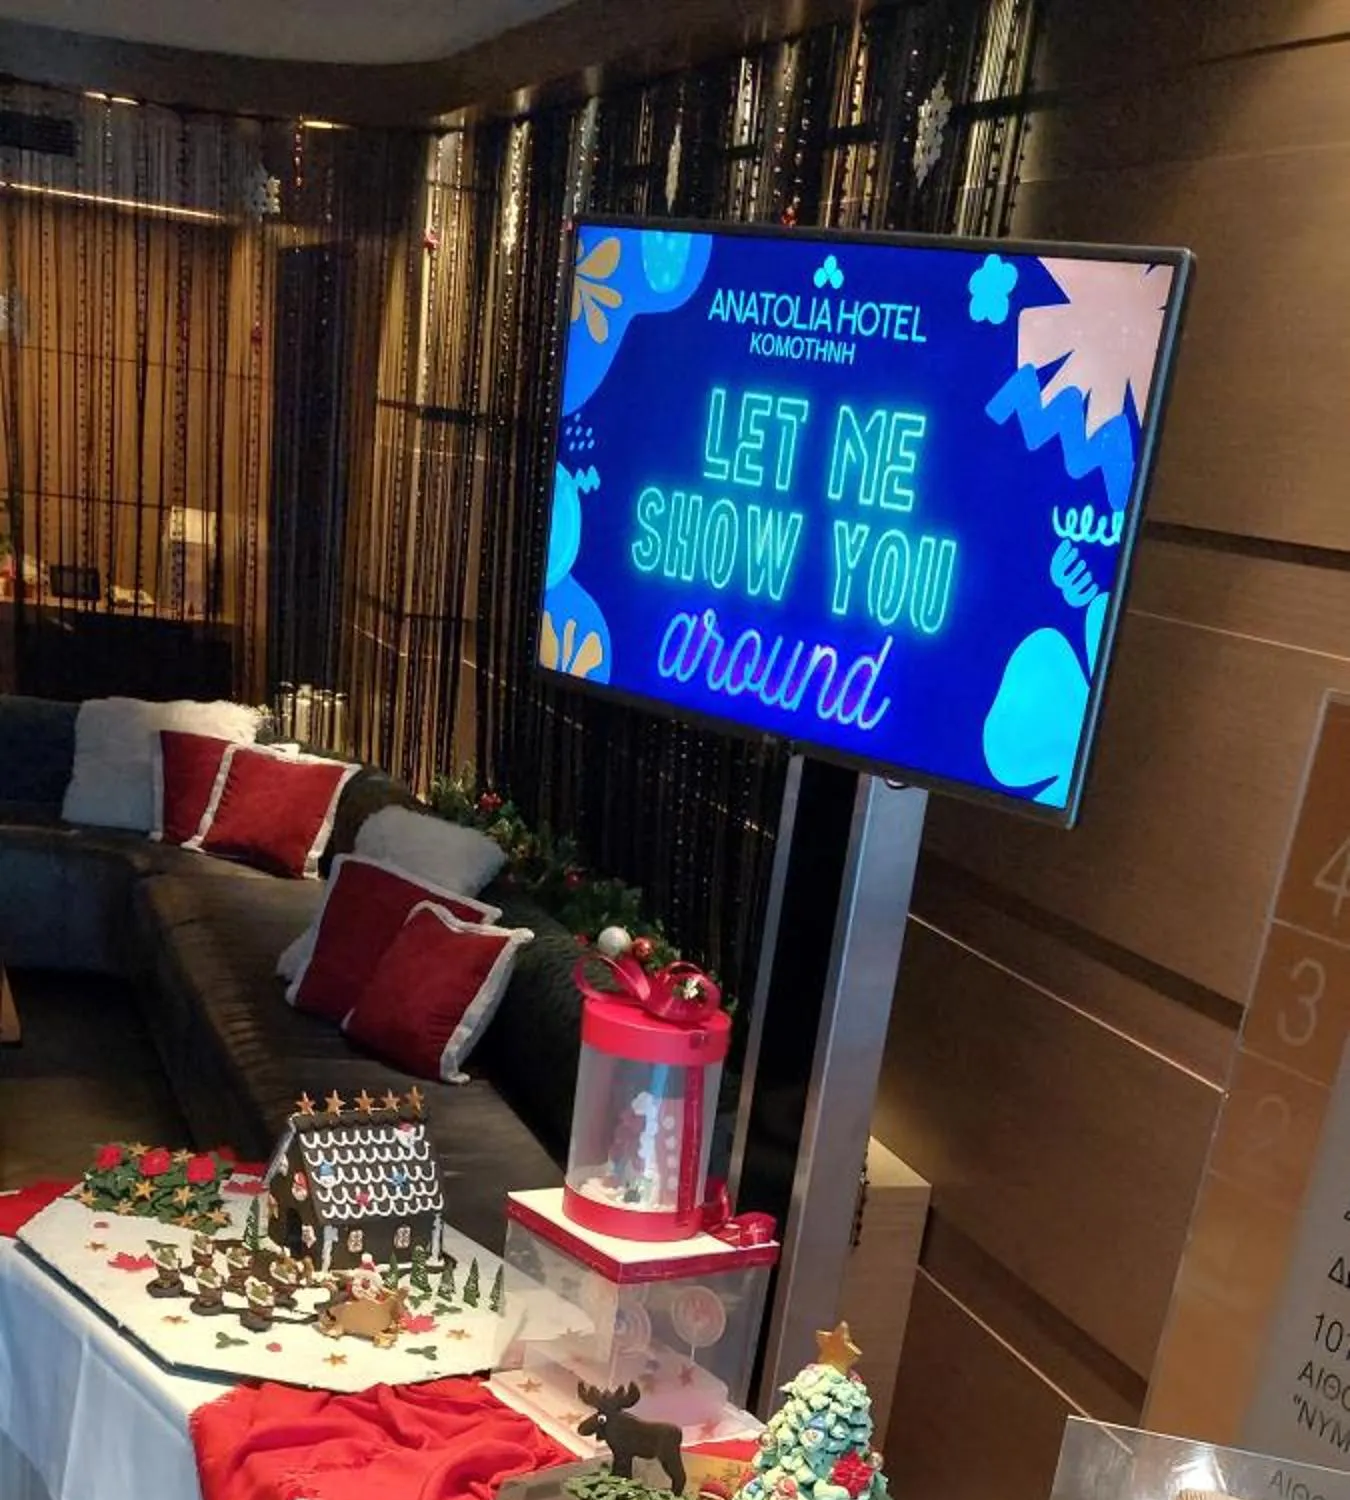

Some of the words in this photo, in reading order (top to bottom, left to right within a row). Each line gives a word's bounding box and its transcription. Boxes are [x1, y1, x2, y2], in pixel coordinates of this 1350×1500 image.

[708, 288, 832, 332] ANATOLIA
[837, 299, 927, 342] HOTEL
[749, 332, 856, 365] ΚΟΜΟΤΗΝΗ
[703, 387, 808, 491] LET
[827, 403, 927, 512] ME
[631, 487, 802, 601] SHOW
[832, 523, 957, 633] YOU
[657, 607, 894, 731] around
[1277, 957, 1326, 1047] 3
